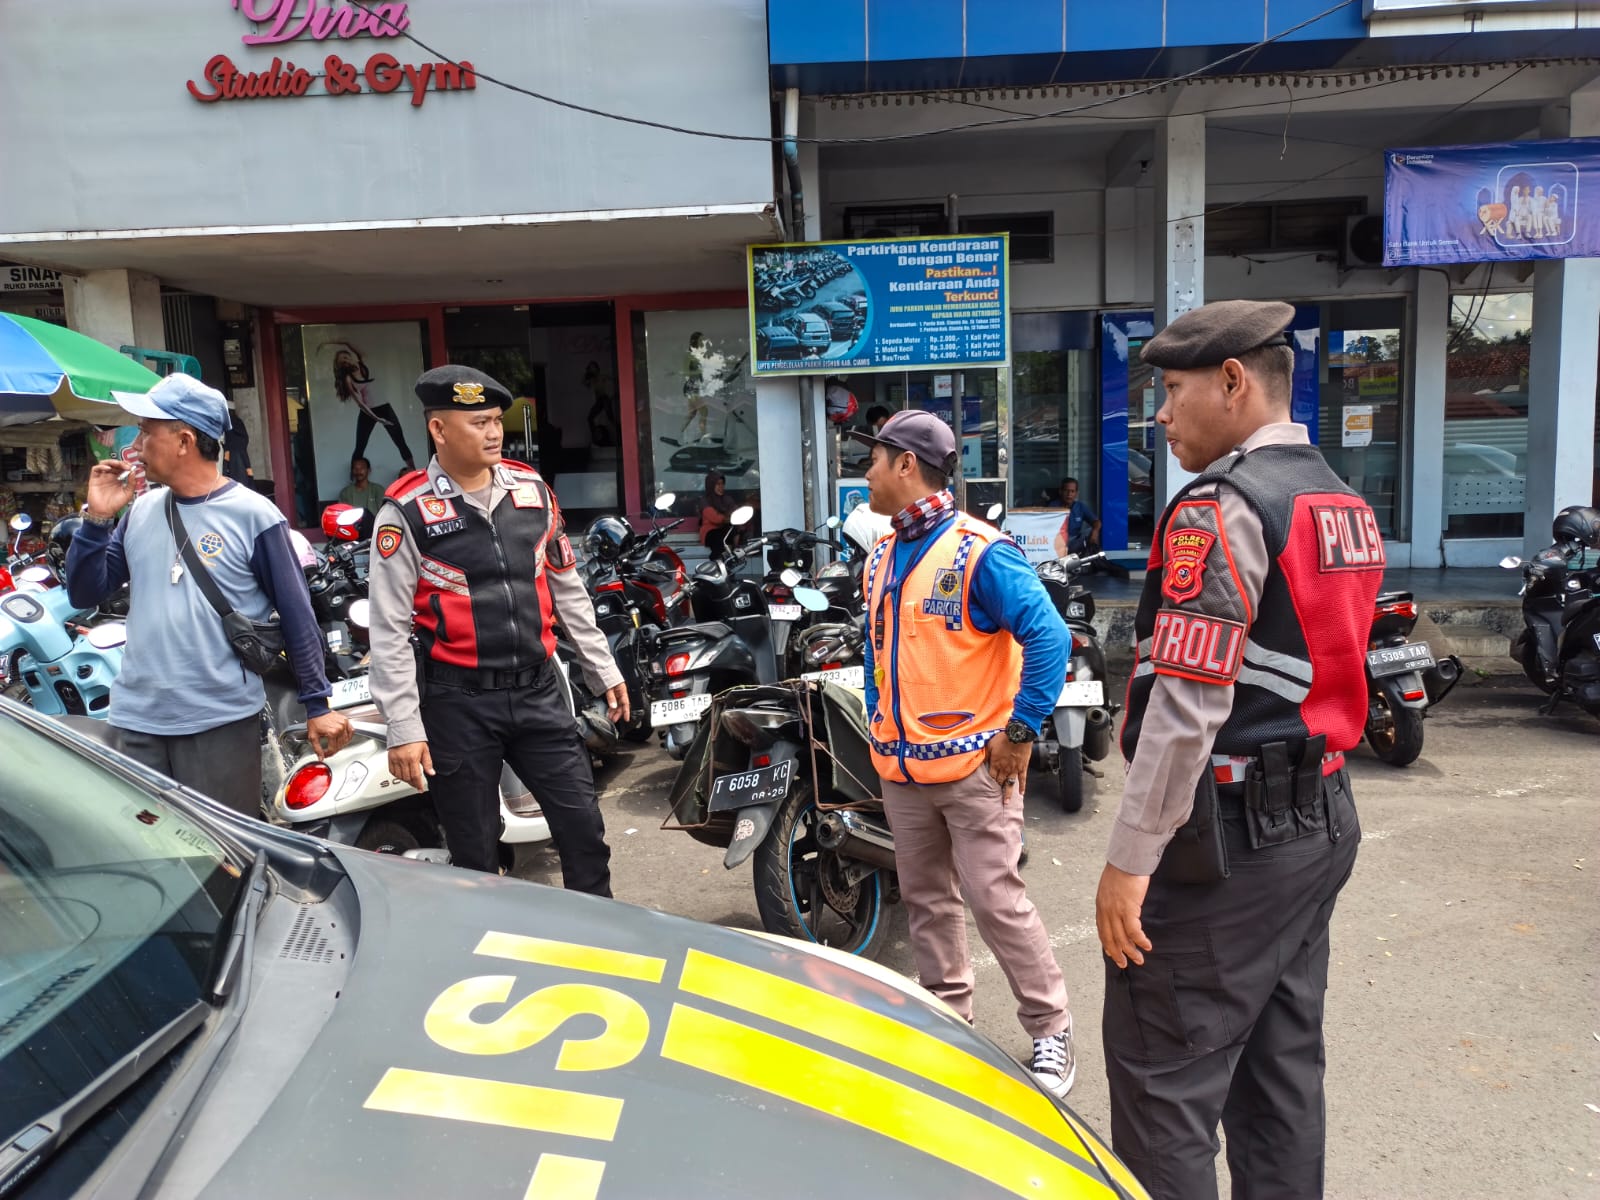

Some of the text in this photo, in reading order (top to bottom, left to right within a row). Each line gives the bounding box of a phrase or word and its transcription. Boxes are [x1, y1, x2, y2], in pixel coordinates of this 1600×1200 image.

[186, 52, 477, 107] Studio & Gym
[847, 240, 1000, 257] Parkirkan Kendaraan
[898, 252, 1000, 267] Dengan Benar
[4, 282, 26, 290] RUKO
[28, 281, 56, 289] PASAR
[889, 277, 1000, 293] Kendaraan Anda
[943, 288, 999, 303] Terkunci
[881, 337, 903, 346] Sepeda
[903, 336, 921, 344] Motor
[982, 341, 1001, 349] Parkir
[982, 349, 1001, 357] Parkir
[923, 600, 961, 616] PARKIR
[1152, 613, 1242, 675] TROLI
[1408, 645, 1427, 658] TAP
[661, 699, 686, 713] 5086
[716, 763, 788, 794] T 6058 KC
[362, 930, 667, 1200] ISI
